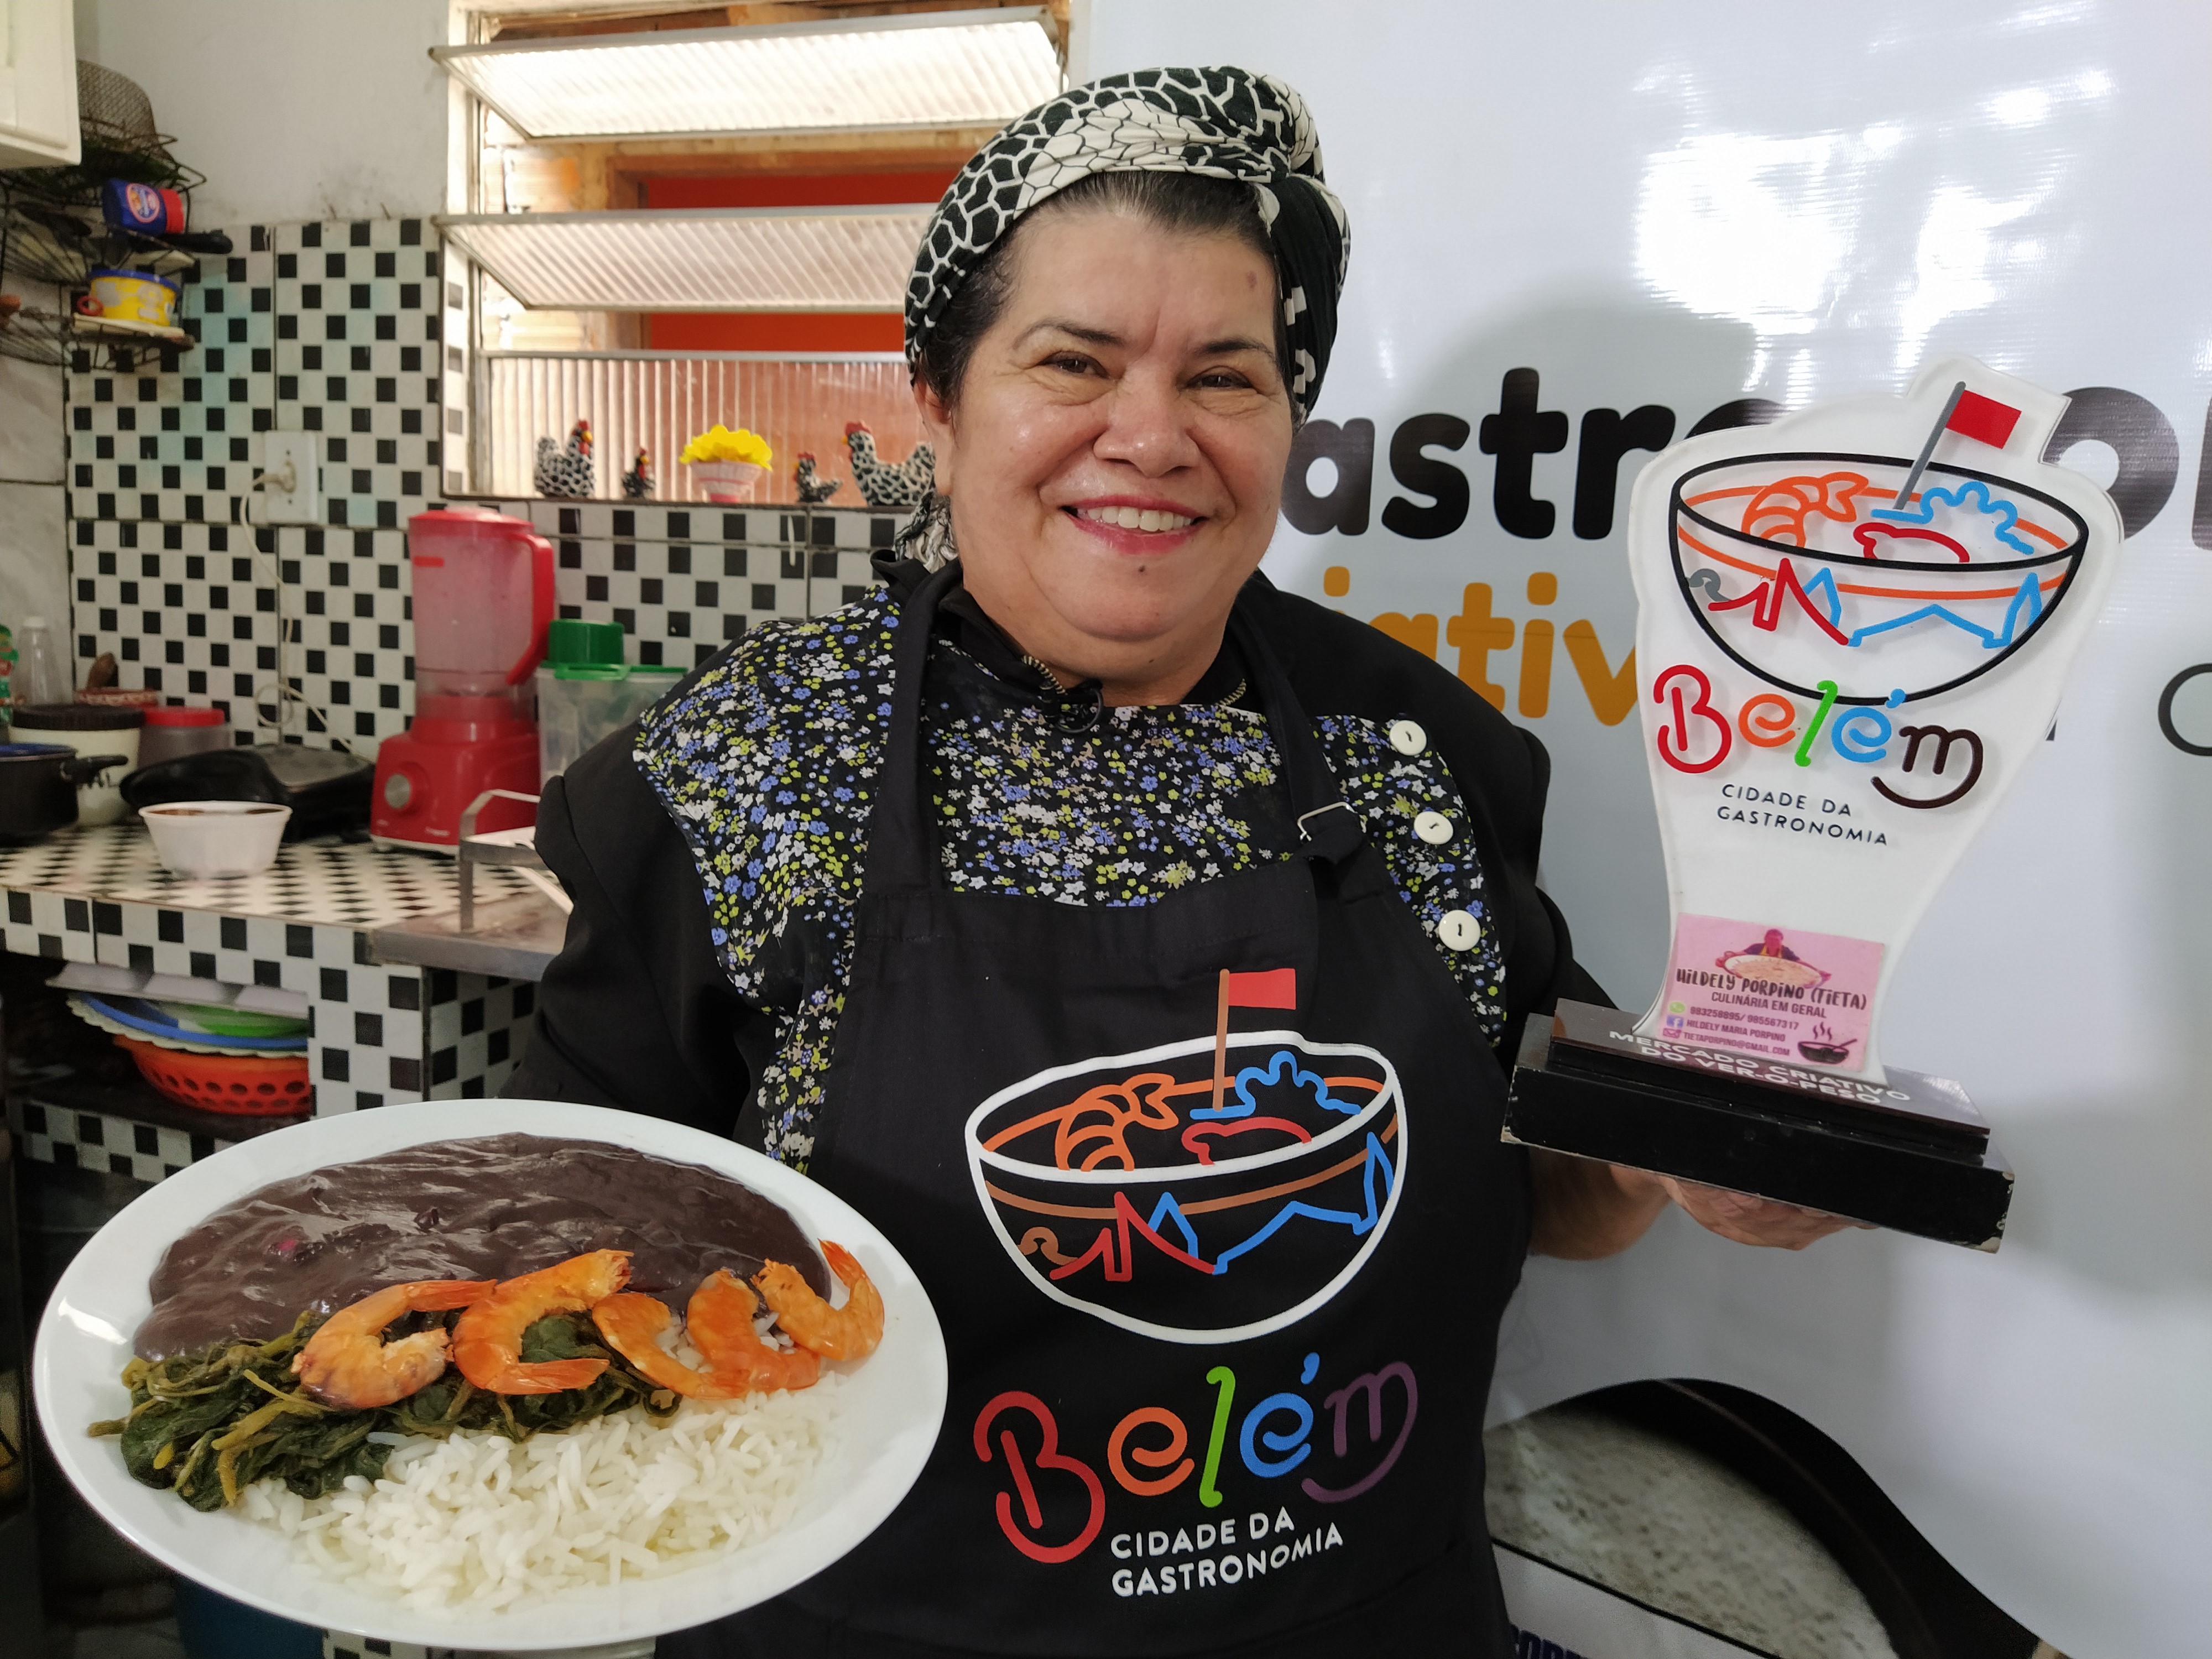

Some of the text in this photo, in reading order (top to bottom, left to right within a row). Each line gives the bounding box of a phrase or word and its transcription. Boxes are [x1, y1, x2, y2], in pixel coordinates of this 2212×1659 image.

[1653, 665, 1983, 808] Belém
[1717, 806, 1887, 846] GASTRONOMIA
[1721, 784, 1851, 817] CIDADE DA
[1687, 1020, 1786, 1042] HILDELY MARIA PORPINO
[1712, 992, 1827, 1018] CULINÁRIA EM GERAL
[1609, 1031, 1910, 1100] MERCADO CRIATIVO
[1641, 1046, 1880, 1103] DO VER-O-PESO
[973, 1352, 1418, 1563] Belém
[1111, 1507, 1295, 1559] CIDADE DA
[1111, 1522, 1343, 1597] GASTRONOMIA
